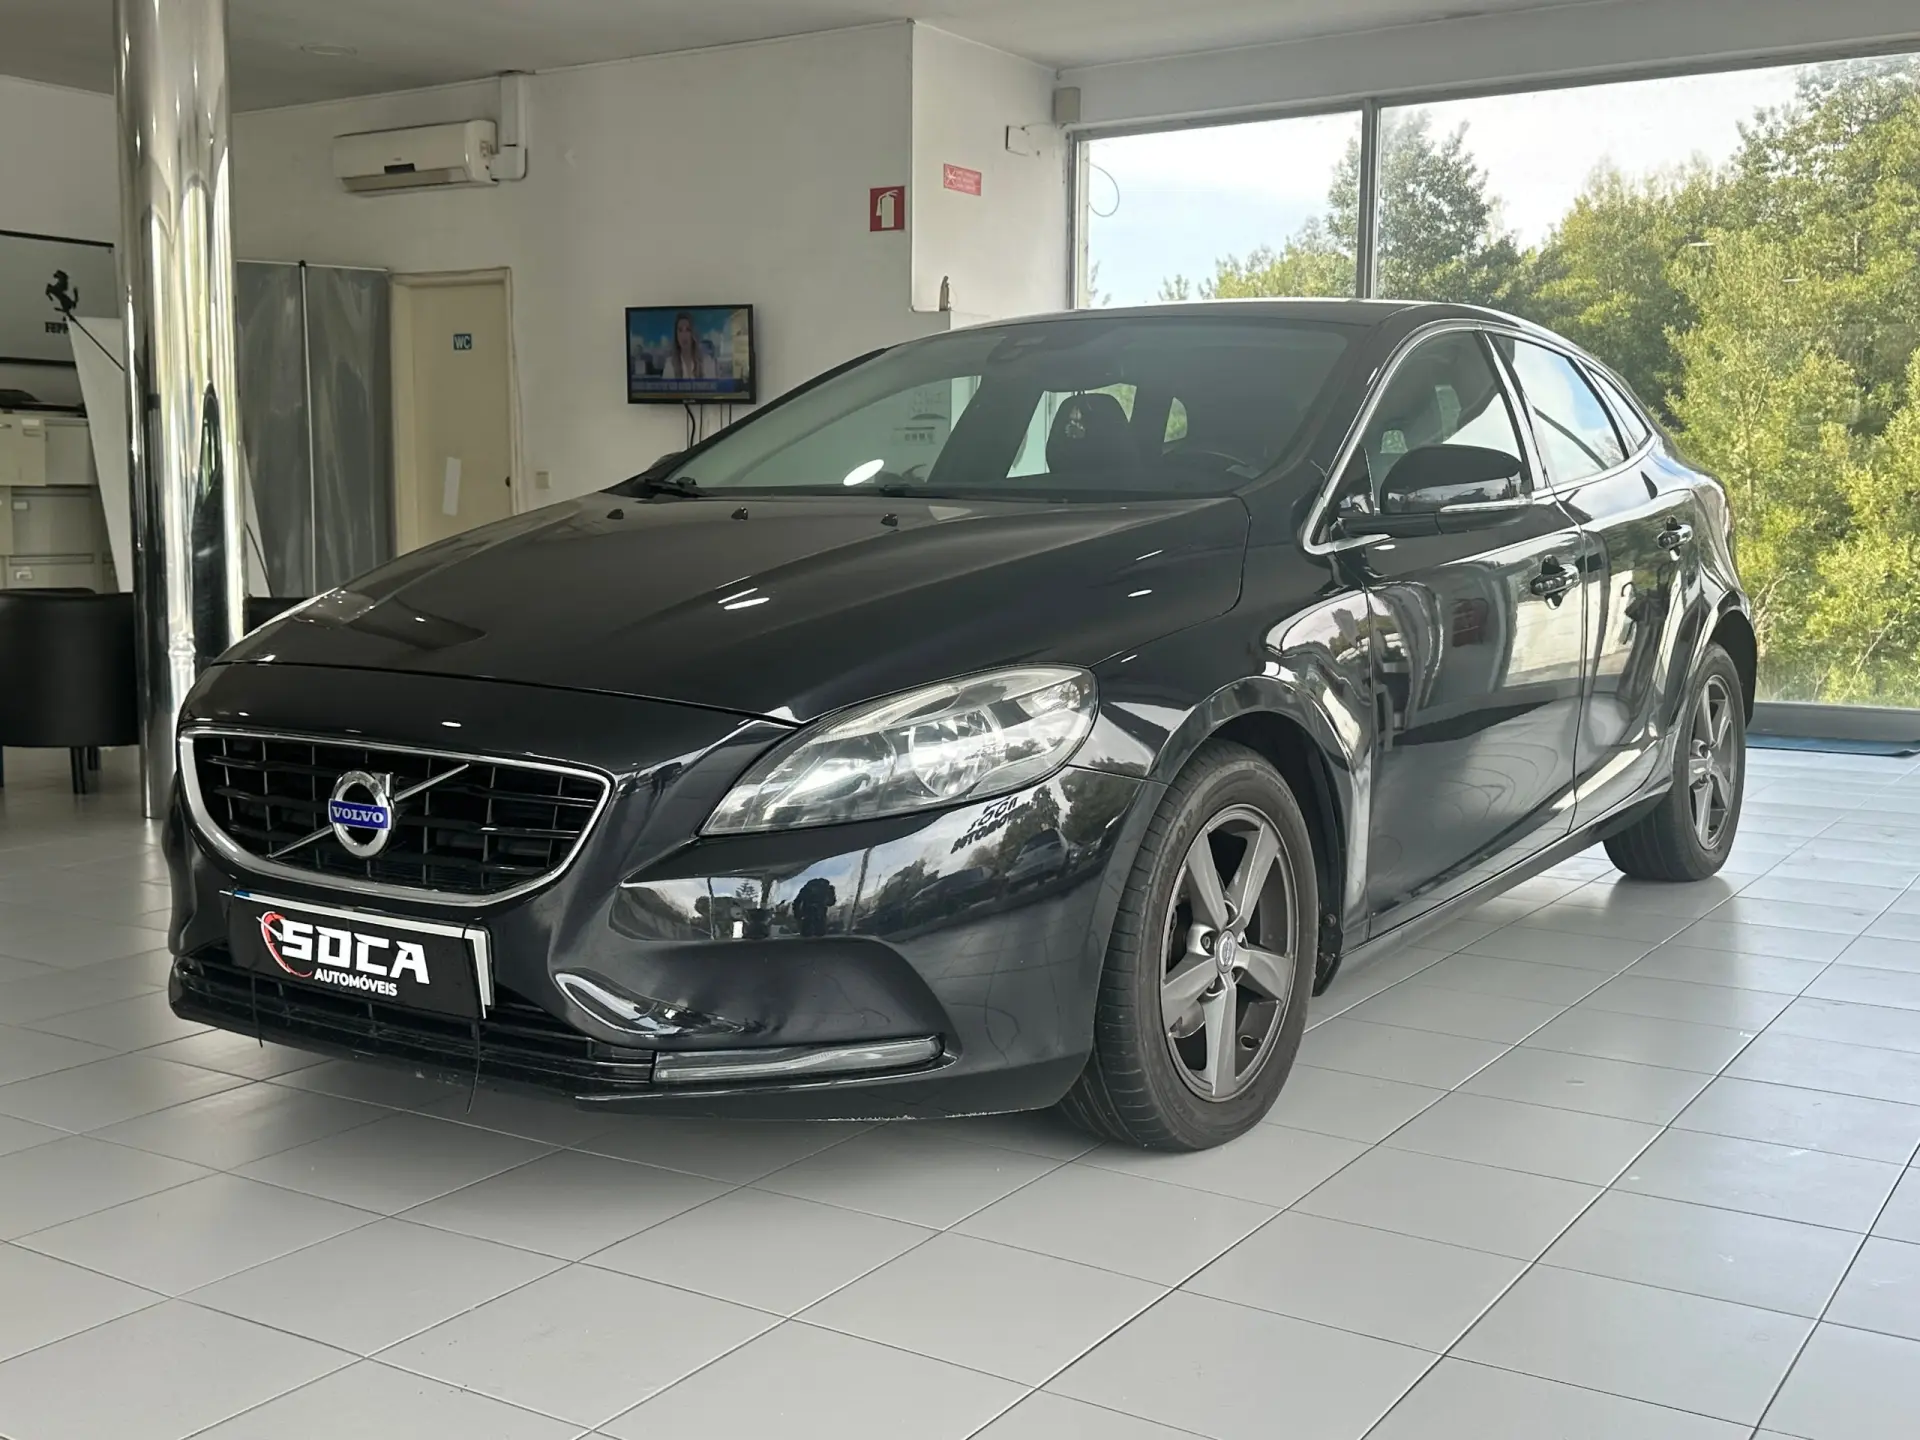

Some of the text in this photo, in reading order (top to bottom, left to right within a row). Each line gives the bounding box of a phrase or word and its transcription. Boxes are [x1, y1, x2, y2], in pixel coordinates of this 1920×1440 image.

[454, 335, 471, 349] WC
[331, 806, 385, 823] VOLVO
[281, 919, 430, 984] SOCA
[314, 968, 398, 997] AUTOMÓVEIS
